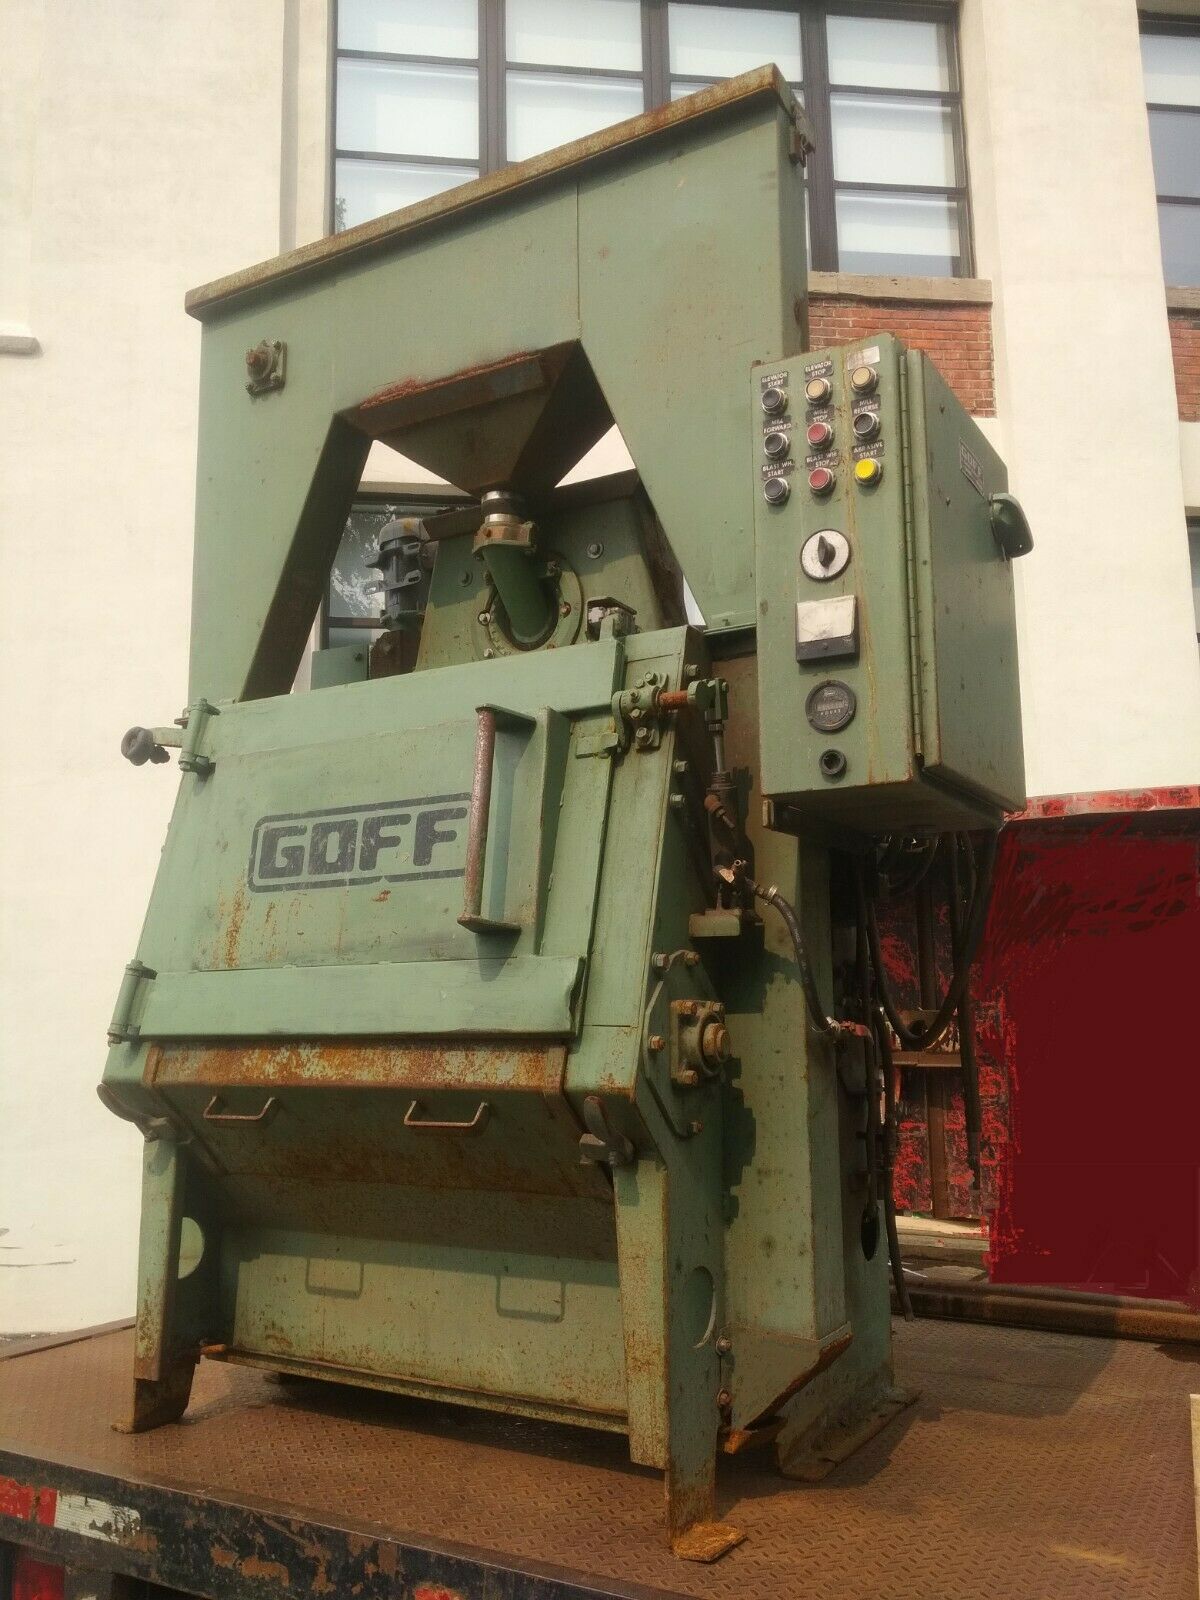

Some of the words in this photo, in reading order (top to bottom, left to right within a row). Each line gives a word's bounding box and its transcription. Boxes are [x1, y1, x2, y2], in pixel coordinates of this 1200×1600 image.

[805, 360, 832, 372] ELEVATOR
[761, 371, 788, 383] ELEVATOR
[811, 368, 826, 377] STOP
[768, 379, 784, 388] START
[859, 399, 873, 407] MILL
[853, 403, 879, 415] REVERSE
[813, 414, 828, 422] STOP
[763, 423, 792, 434] FORWARD
[853, 441, 884, 453] ABRASIVE
[806, 454, 824, 463] BLAST
[859, 449, 878, 459] START
[762, 464, 780, 472] BLAST
[815, 459, 830, 468] STOP
[767, 468, 784, 478] START
[258, 806, 468, 880] GOFF
